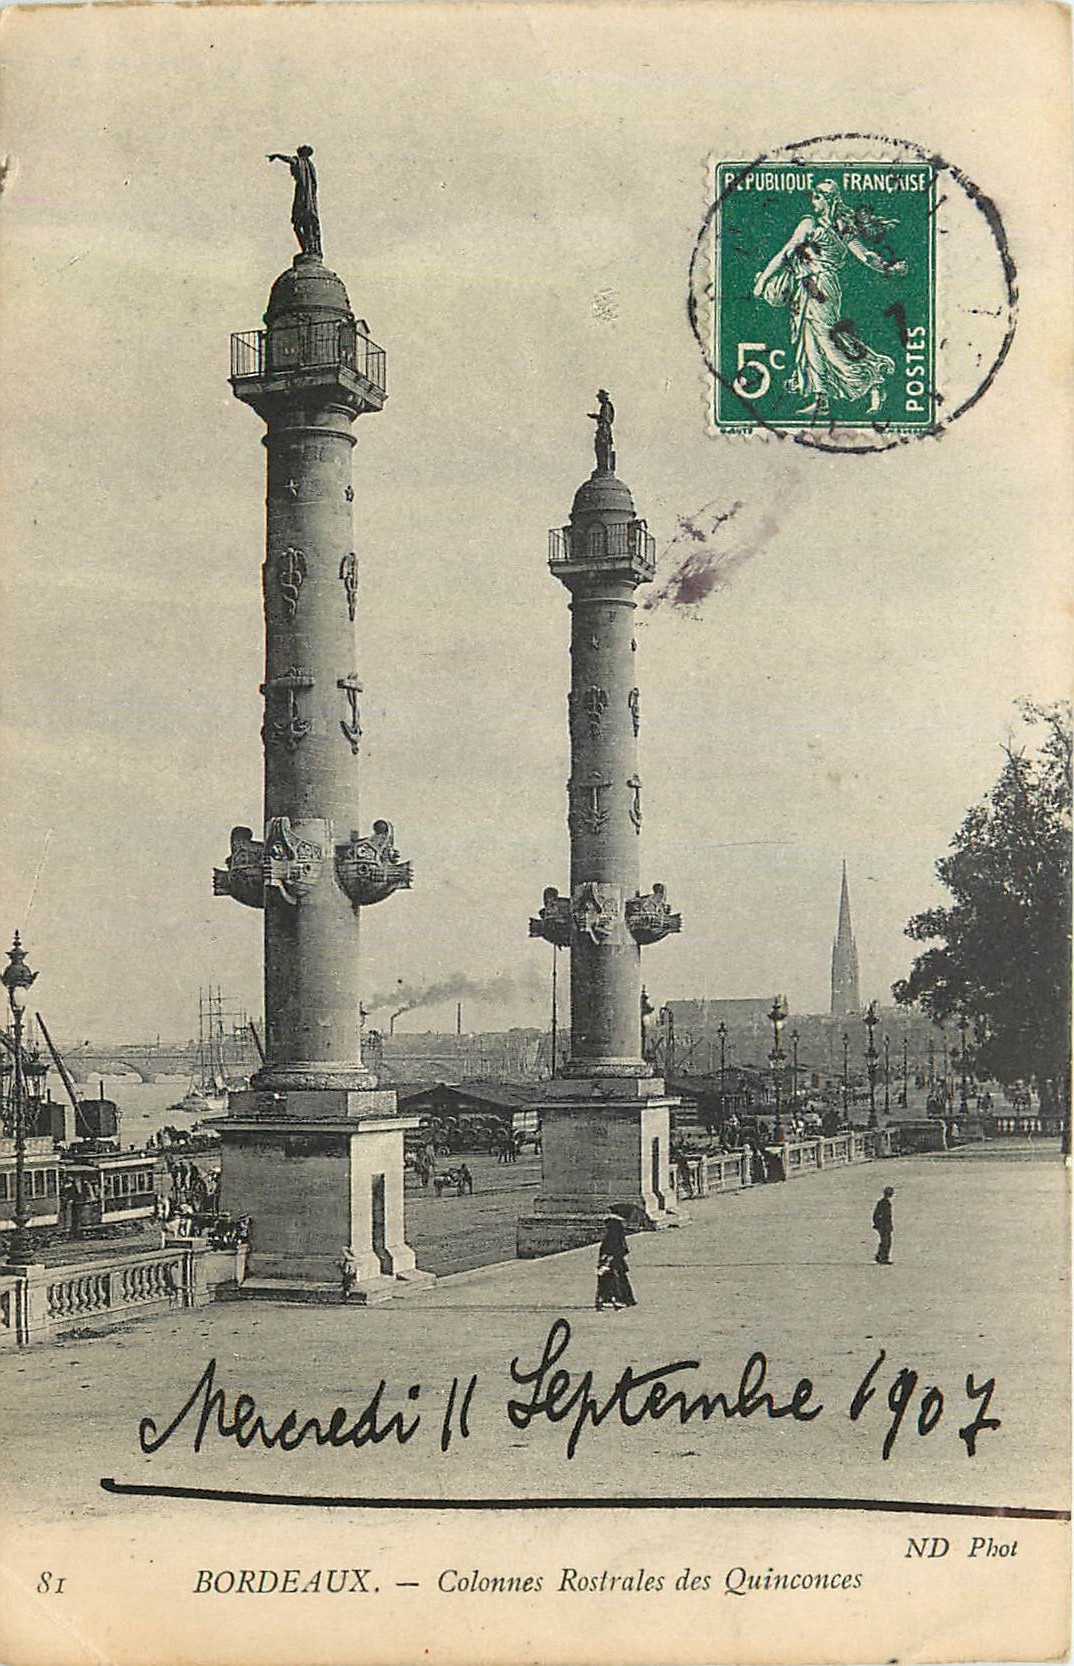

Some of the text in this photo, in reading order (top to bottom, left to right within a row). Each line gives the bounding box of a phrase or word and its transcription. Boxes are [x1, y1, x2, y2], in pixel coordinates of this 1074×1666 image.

[906, 326, 926, 412] POSTES
[139, 1318, 1001, 1461] Mercredi 11 Septembre 1907
